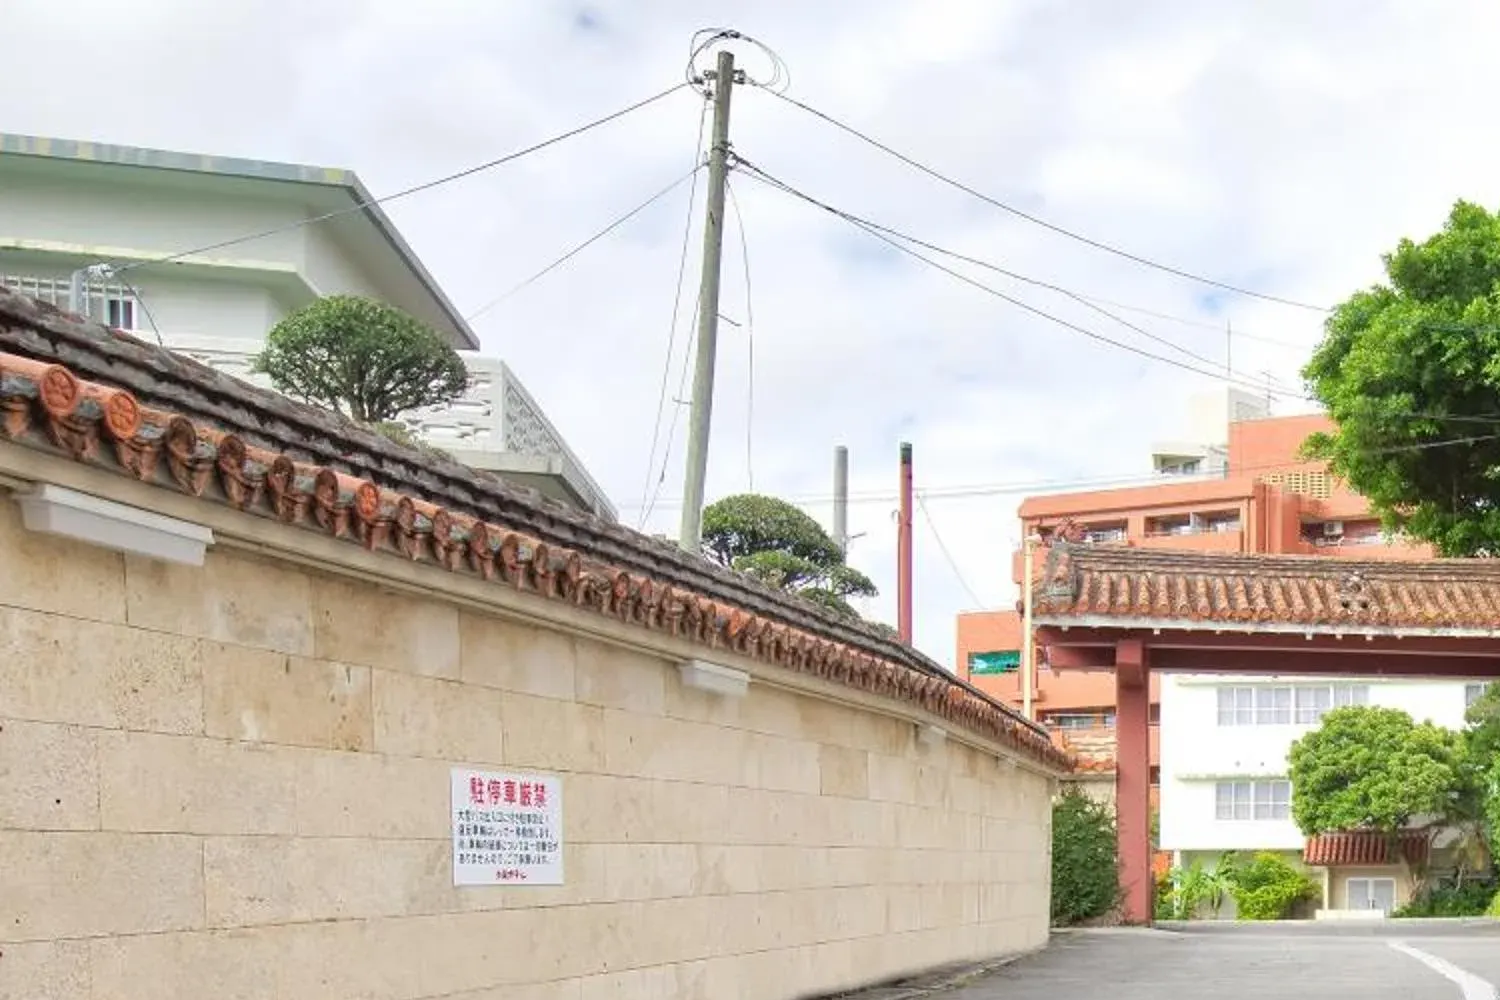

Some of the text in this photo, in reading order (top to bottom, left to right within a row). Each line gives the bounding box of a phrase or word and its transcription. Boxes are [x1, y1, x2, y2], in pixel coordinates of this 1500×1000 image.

[470, 777, 546, 807] 駐停車厳禁
